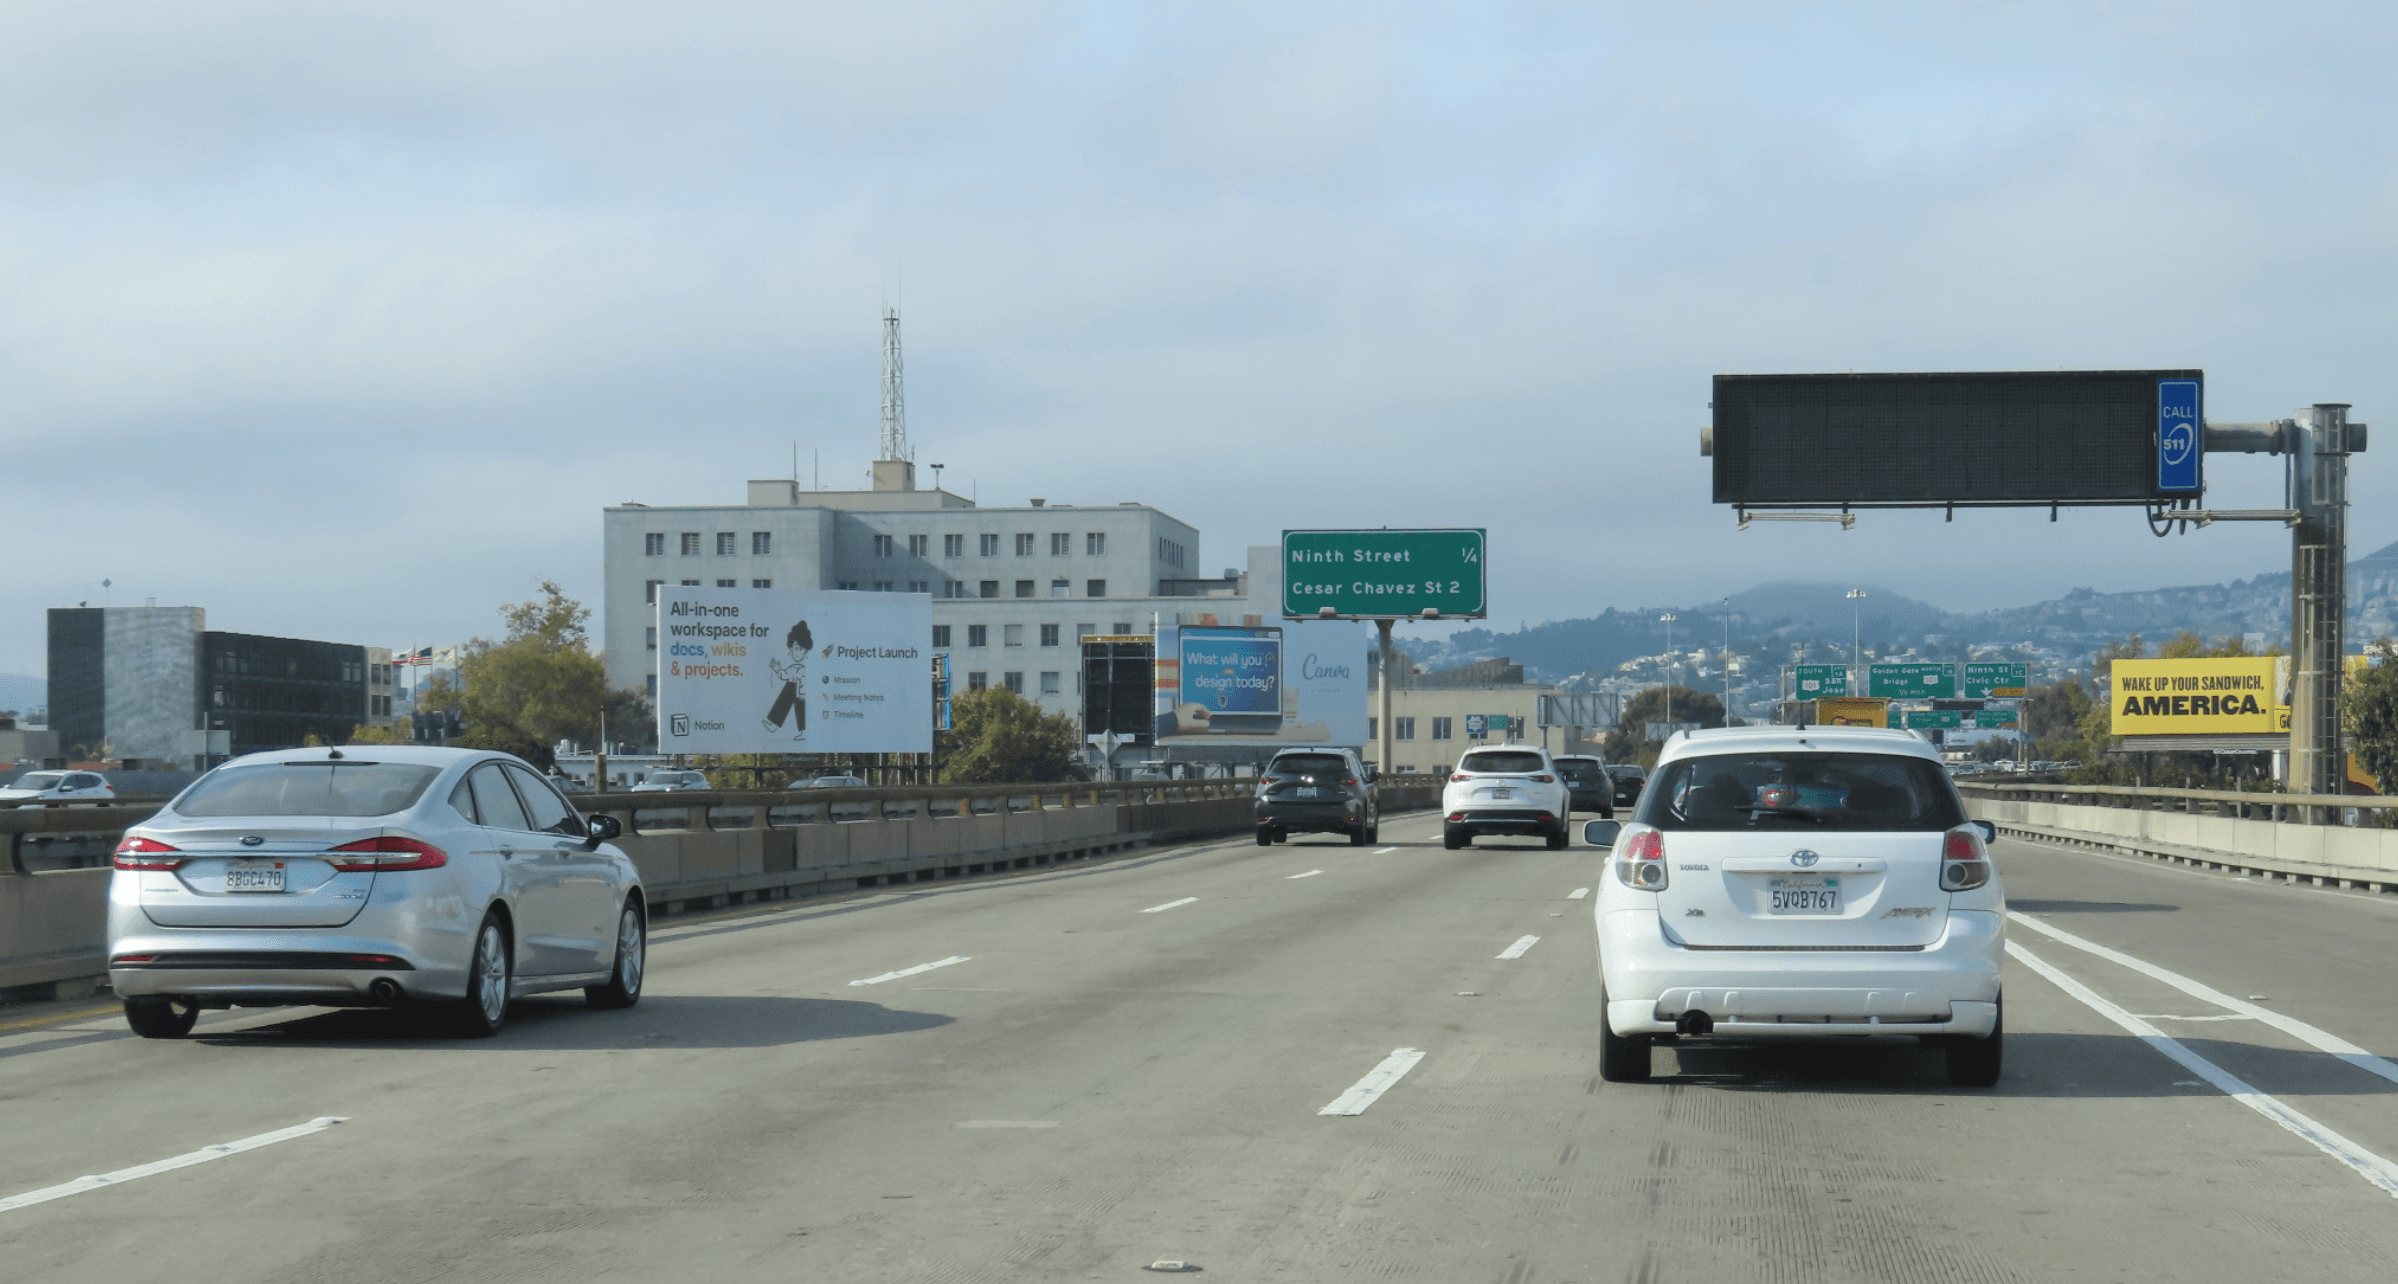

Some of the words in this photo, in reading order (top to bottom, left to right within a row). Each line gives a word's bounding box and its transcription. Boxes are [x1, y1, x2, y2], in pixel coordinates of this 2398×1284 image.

[2163, 406, 2194, 418] CALL
[2163, 438, 2185, 450] 511
[1292, 550, 1344, 563] Ninth
[1354, 549, 1411, 563] Street
[1292, 582, 1343, 595] Cesar
[1352, 581, 1416, 595] Chavez
[1424, 581, 1443, 594] St
[1449, 581, 1461, 594] 2
[670, 601, 740, 617] All-in-one
[670, 622, 747, 641] workspace
[749, 622, 770, 638] for
[670, 641, 708, 660] docs,
[711, 641, 747, 657] wikis
[837, 645, 877, 661] Project
[878, 646, 918, 659] Launch
[1186, 652, 1219, 665] What
[1220, 652, 1239, 665] will
[1240, 655, 1263, 669] you
[1302, 653, 1350, 681] Canva
[670, 660, 681, 676] &
[684, 661, 744, 680] projects.
[1967, 666, 1994, 674] Ninth
[1998, 665, 2009, 674] St
[833, 675, 861, 684] Mission
[1194, 674, 1233, 691] design
[1236, 675, 1275, 692] today?
[1825, 677, 1842, 685] San
[1883, 678, 1908, 686] Bridge
[1966, 676, 1990, 685] Civic
[1993, 676, 2010, 685] Ctr
[2121, 676, 2152, 692] WAKE
[2154, 676, 2169, 692] UP
[2170, 676, 2199, 691] YOUR
[2201, 675, 2265, 691] SANDWICH,
[1822, 686, 1845, 694] Jose
[833, 693, 862, 703] Meeting
[863, 693, 885, 701] Notes
[2121, 694, 2267, 717] AMERICA.
[833, 710, 864, 719] Timeline
[694, 720, 725, 731] Notion
[226, 870, 281, 886] 8BGC470
[1772, 890, 1837, 909] 5VQB767
